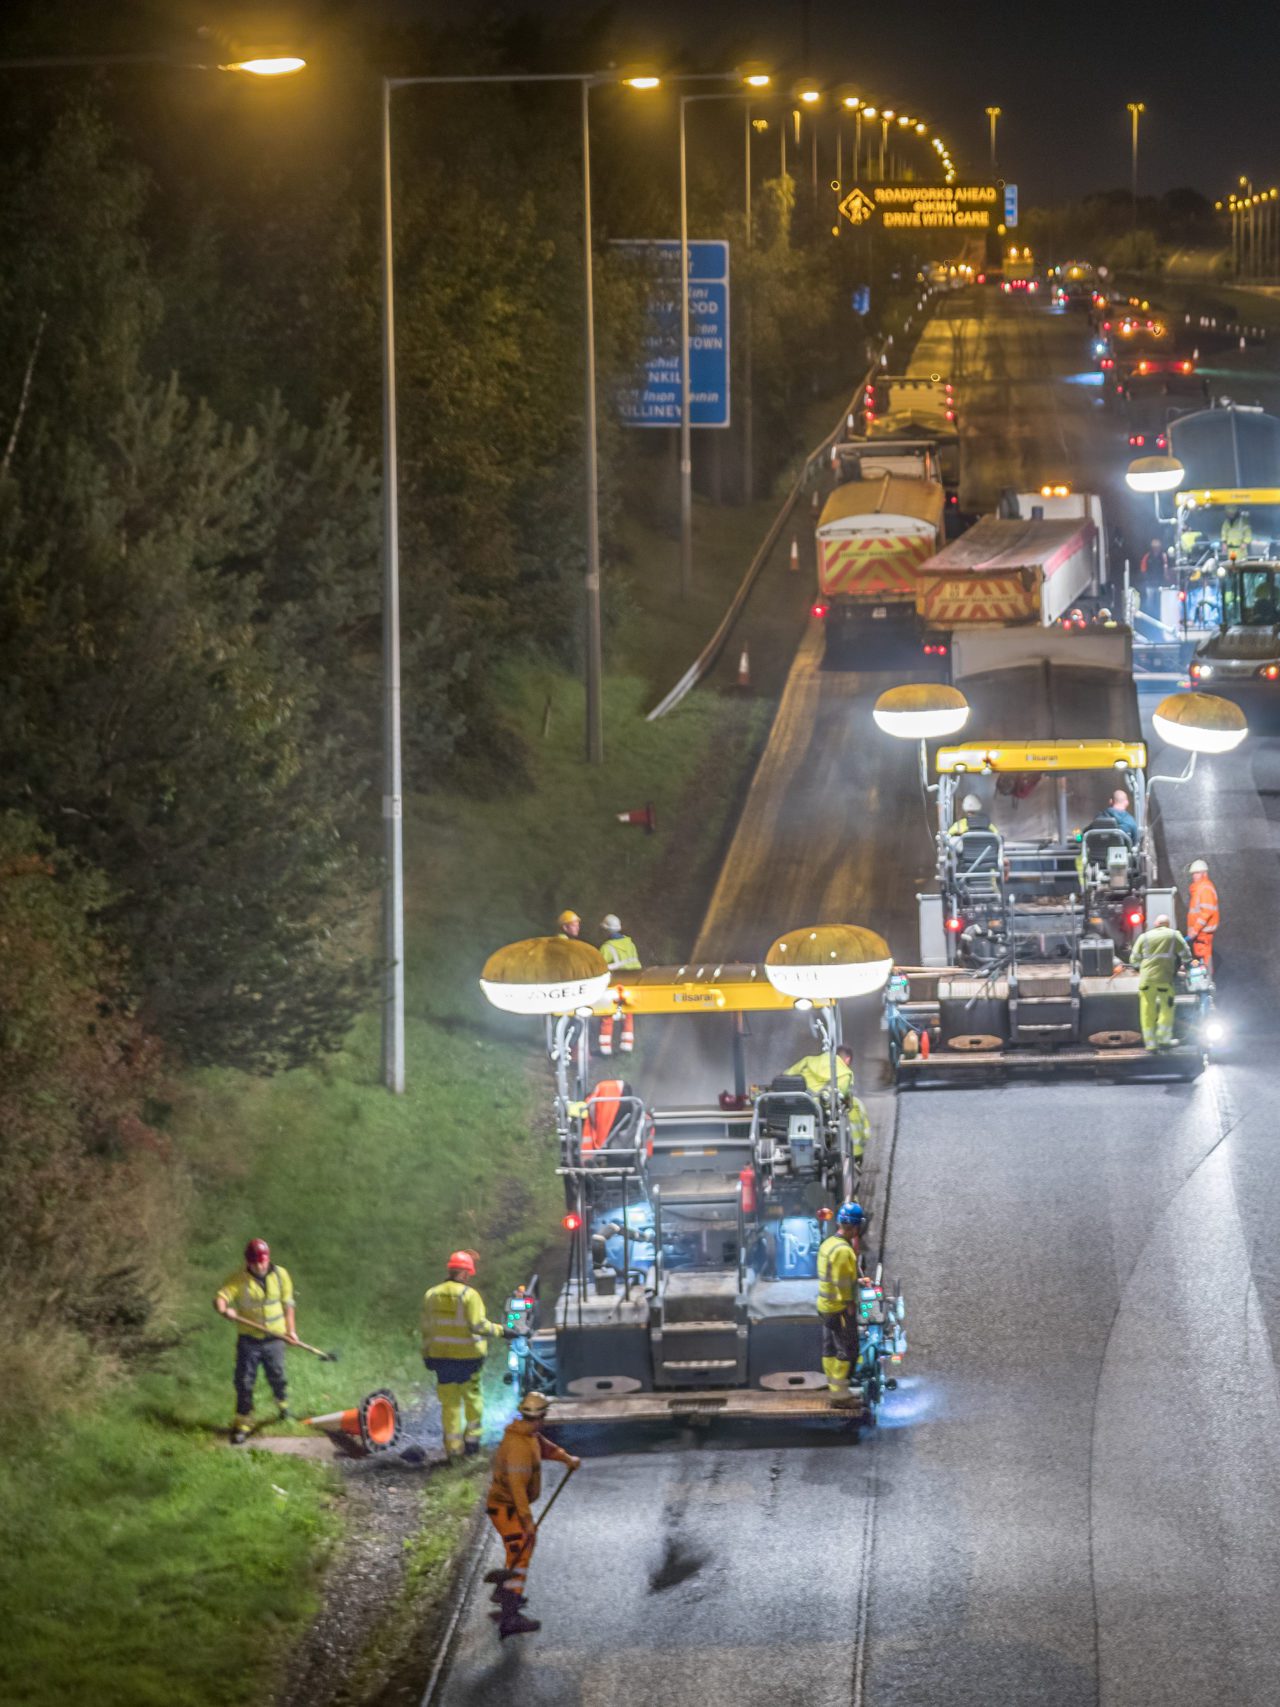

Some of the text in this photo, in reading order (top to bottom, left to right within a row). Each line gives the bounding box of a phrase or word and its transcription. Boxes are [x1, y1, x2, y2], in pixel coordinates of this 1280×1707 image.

[874, 187, 996, 202] ROADWORKS AHEAD
[883, 211, 989, 227] DRIVE WITH CARE
